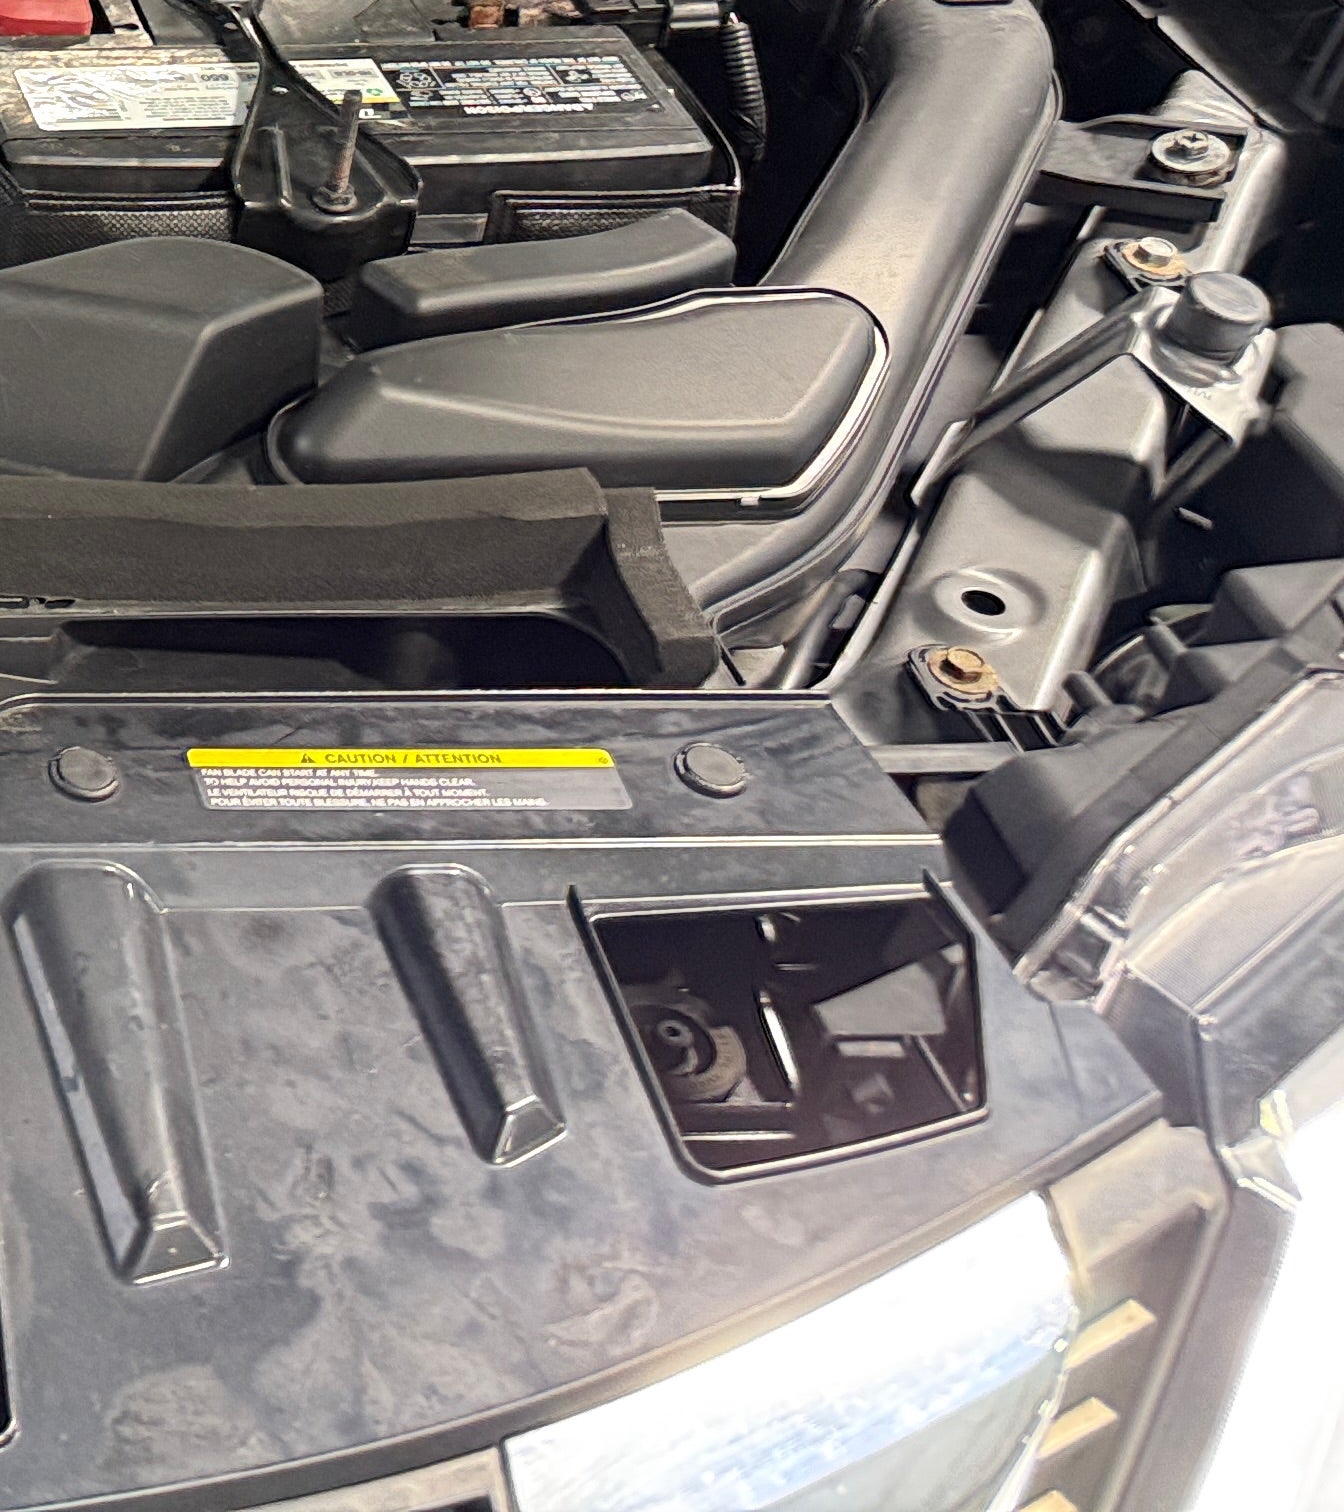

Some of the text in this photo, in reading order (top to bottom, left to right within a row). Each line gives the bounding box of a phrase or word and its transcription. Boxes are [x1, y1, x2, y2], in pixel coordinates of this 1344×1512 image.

[325, 753, 396, 764] CAUTION
[415, 753, 501, 764] ATTENTION
[257, 769, 281, 777] CAN
[204, 778, 219, 786] TO
[220, 778, 247, 786] HELP
[248, 778, 281, 786] AVOID
[281, 778, 337, 786] PERSONAL
